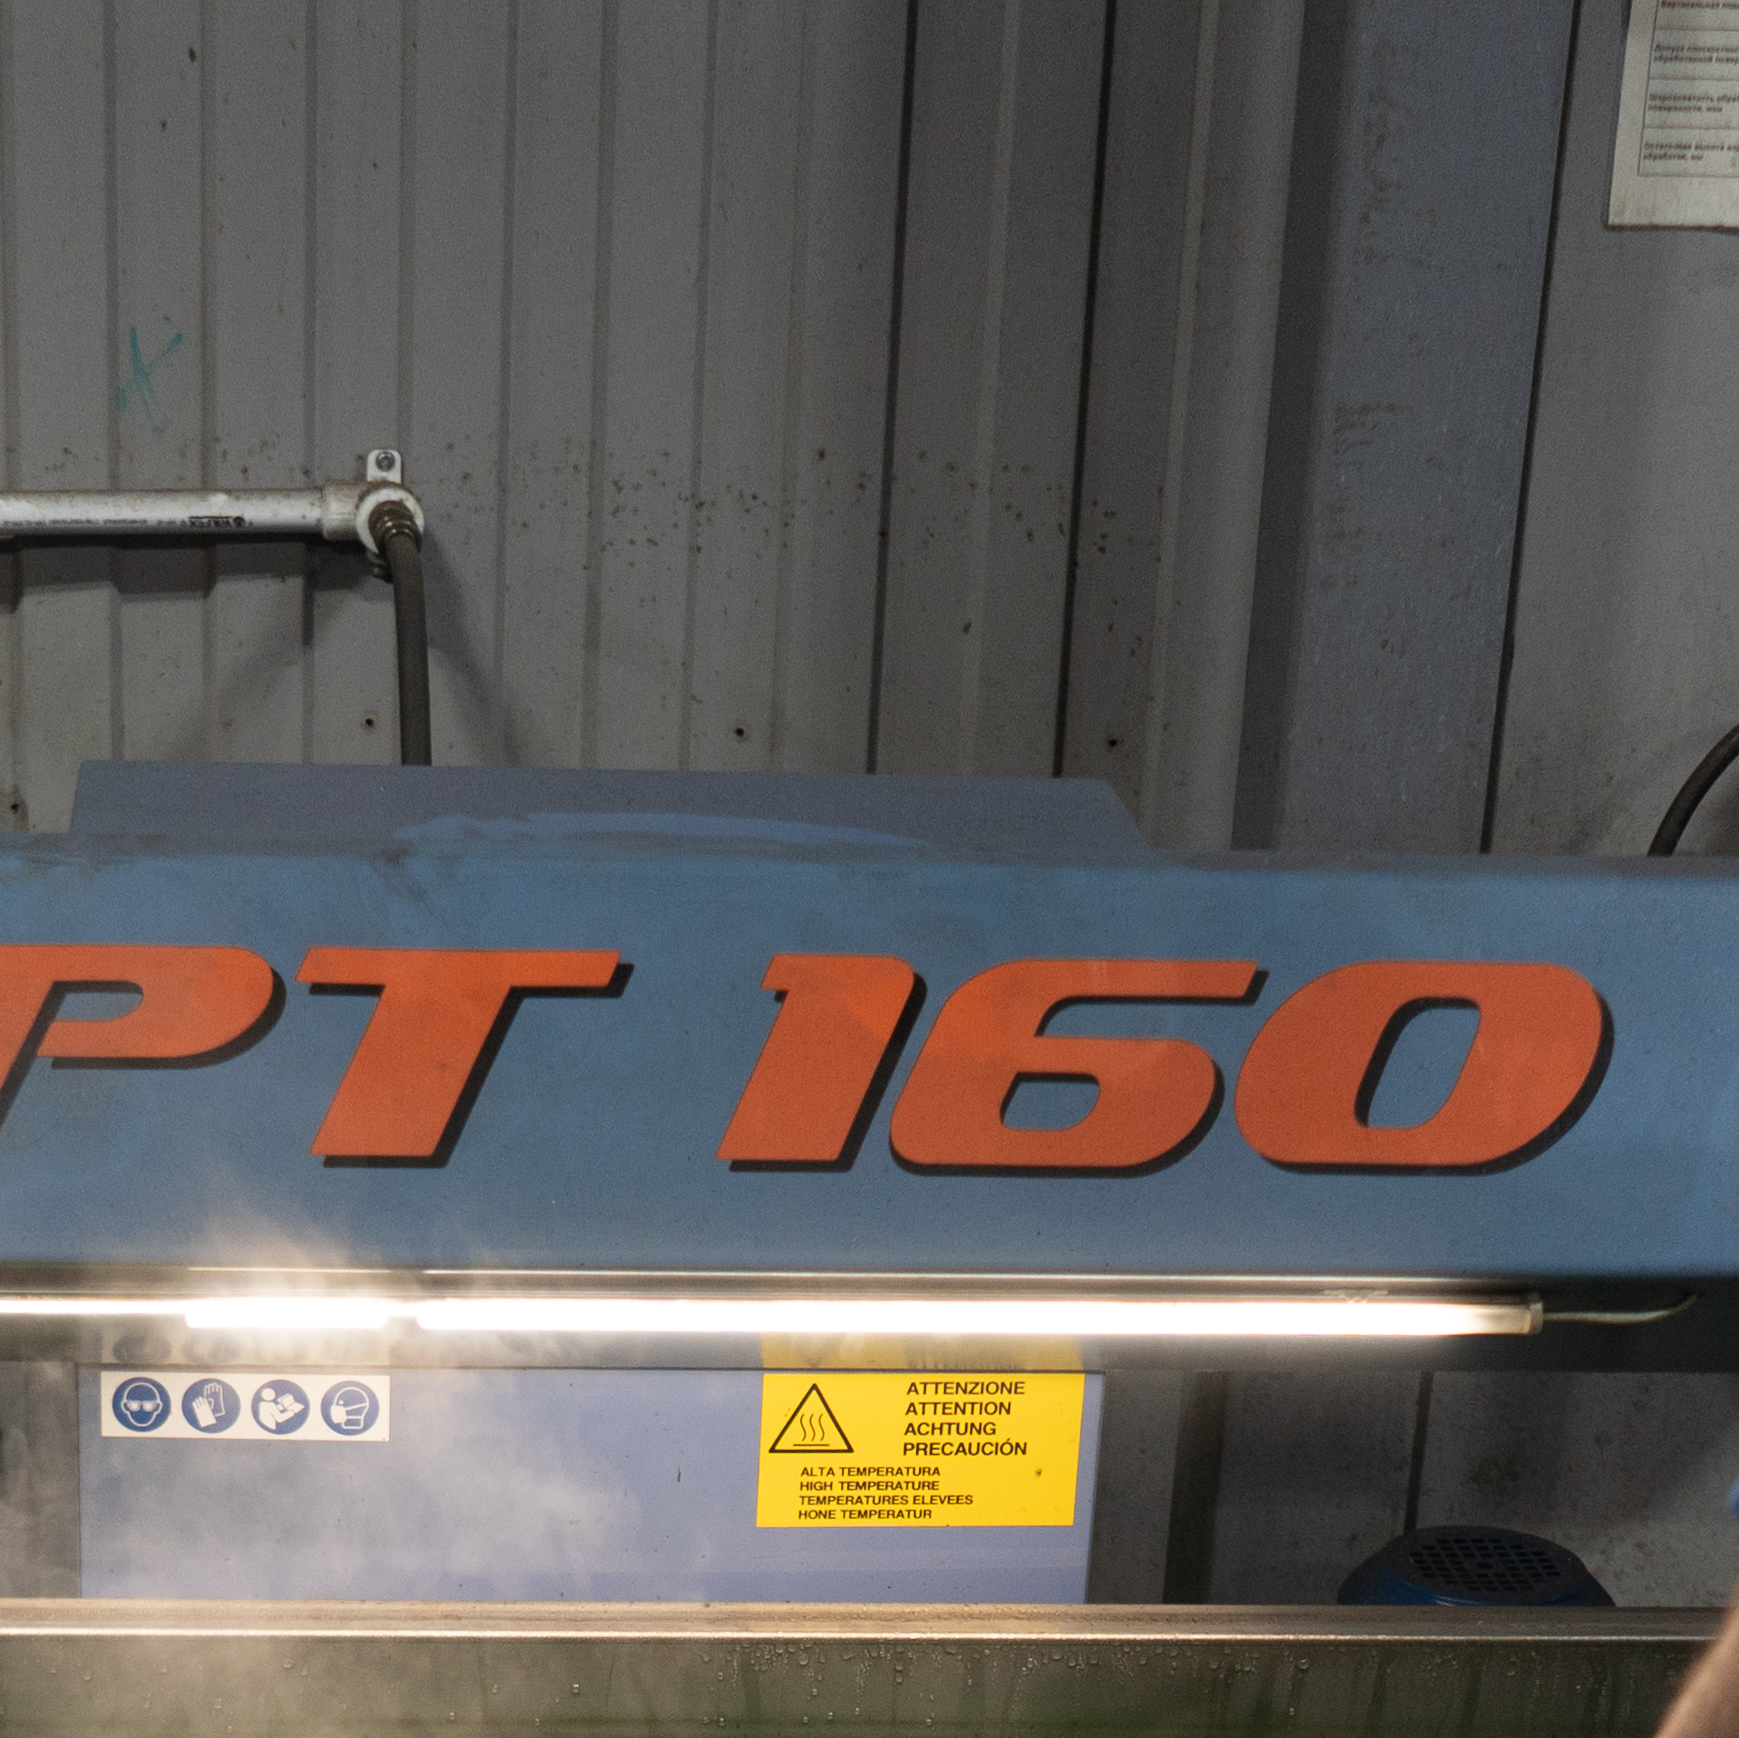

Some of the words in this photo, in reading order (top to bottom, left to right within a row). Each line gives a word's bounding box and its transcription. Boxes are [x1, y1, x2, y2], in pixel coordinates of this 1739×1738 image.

[718, 954, 1609, 1172] 160
[906, 1381, 1026, 1396] ATTENZIONE
[904, 1401, 1012, 1416] ATTENTION
[903, 1422, 997, 1437] ACHTUNG
[902, 1437, 1028, 1456] PRECAUCIÓN
[800, 1467, 835, 1477] ALTA
[839, 1466, 941, 1477] TEMPERATURA
[800, 1481, 833, 1491] HIGH
[839, 1481, 940, 1491] TEMPERATURE
[799, 1495, 909, 1506] TEMPERATURES
[913, 1495, 974, 1505] ELEVEES
[798, 1510, 837, 1520] HONE
[841, 1509, 933, 1520] TEMPERATUR
